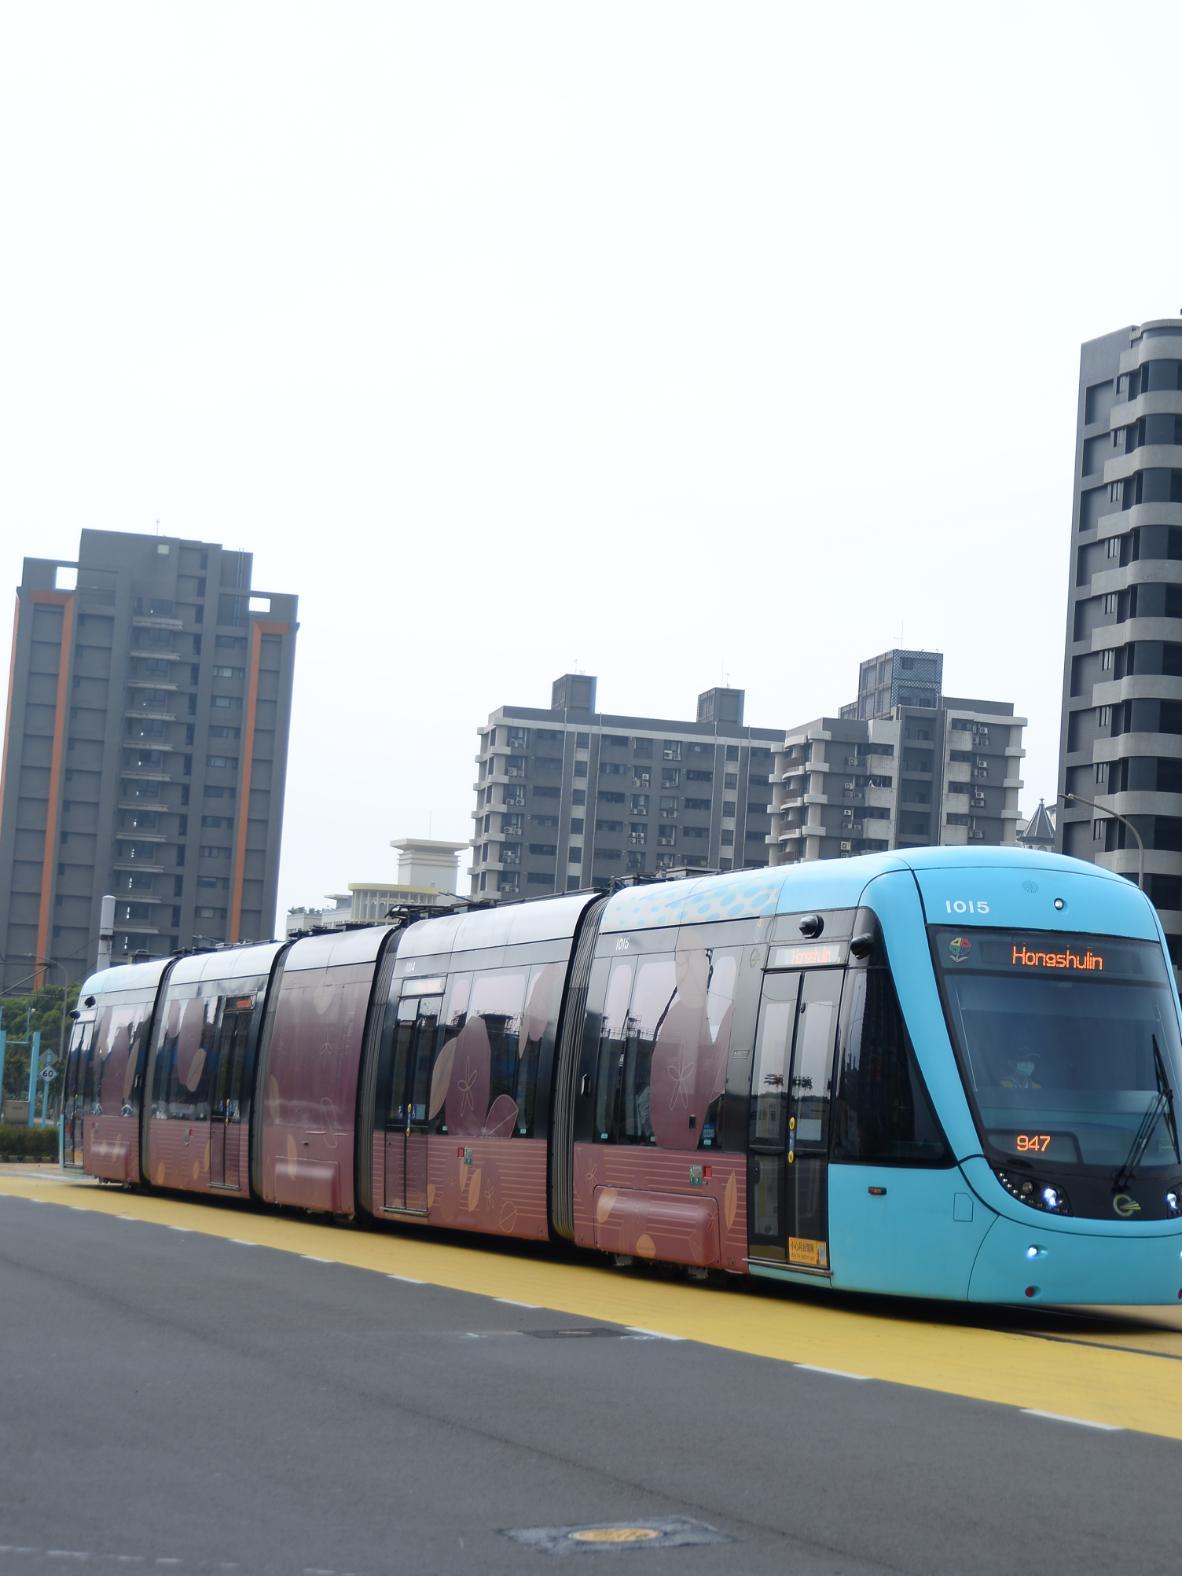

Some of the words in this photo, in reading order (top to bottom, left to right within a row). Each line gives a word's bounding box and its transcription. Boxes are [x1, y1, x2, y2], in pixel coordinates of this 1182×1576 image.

[945, 900, 990, 914] 1015
[1011, 945, 1104, 971] Hongshulin
[42, 1070, 54, 1078] 60
[1016, 1135, 1051, 1151] 947
